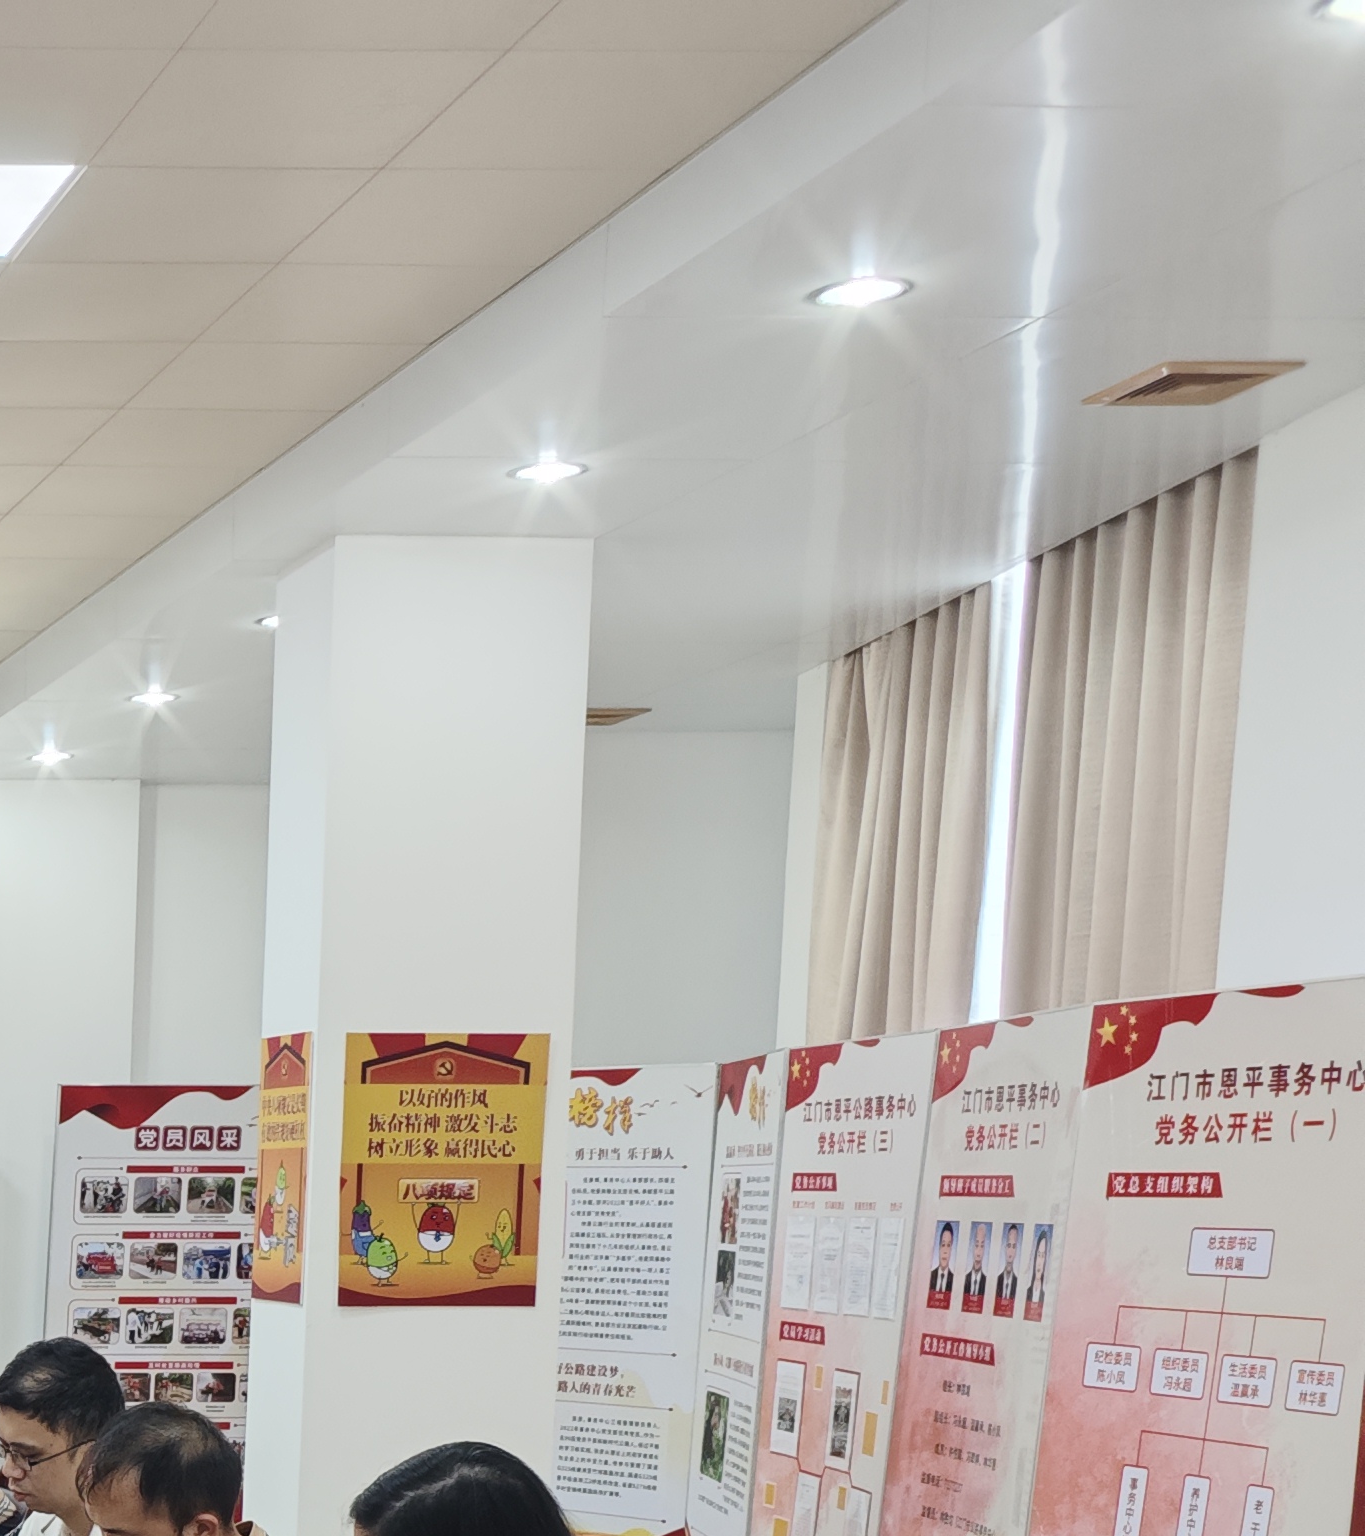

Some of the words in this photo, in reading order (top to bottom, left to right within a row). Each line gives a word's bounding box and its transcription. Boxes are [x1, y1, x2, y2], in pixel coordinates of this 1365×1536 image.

[1146, 1060, 1365, 1102] 江门市恩平事务中心
[398, 1088, 489, 1109] 以好的作风
[961, 1080, 1061, 1114] 江门市恩平事务中心
[568, 1086, 634, 1136] 榜样
[802, 1094, 917, 1123] 江门市恩平公路事务中心
[368, 1112, 441, 1133] 振奋精神
[444, 1112, 518, 1134] 激发斗志
[1154, 1108, 1337, 1146] 党务公开栏（一）
[137, 1128, 239, 1148] 党员风采
[817, 1129, 894, 1155] 党务公开栏（三）
[964, 1121, 1047, 1152] 党务公开栏（二）
[367, 1138, 440, 1158] 树立形象
[444, 1138, 516, 1158] 赢得民心
[575, 1147, 621, 1161] 勇于担当
[627, 1146, 675, 1161] 乐于助人
[402, 1182, 475, 1201] 八项规定
[1112, 1175, 1214, 1195] 党总支组织架构
[1206, 1236, 1257, 1251] 总支部书记
[1214, 1256, 1244, 1271] 林良端
[1093, 1349, 1132, 1367] 纪检委员
[1161, 1356, 1200, 1374] 组织委员
[1228, 1362, 1267, 1380] 生活委员
[1296, 1369, 1335, 1388] 宣传委员
[1162, 1375, 1192, 1393] 冯永超
